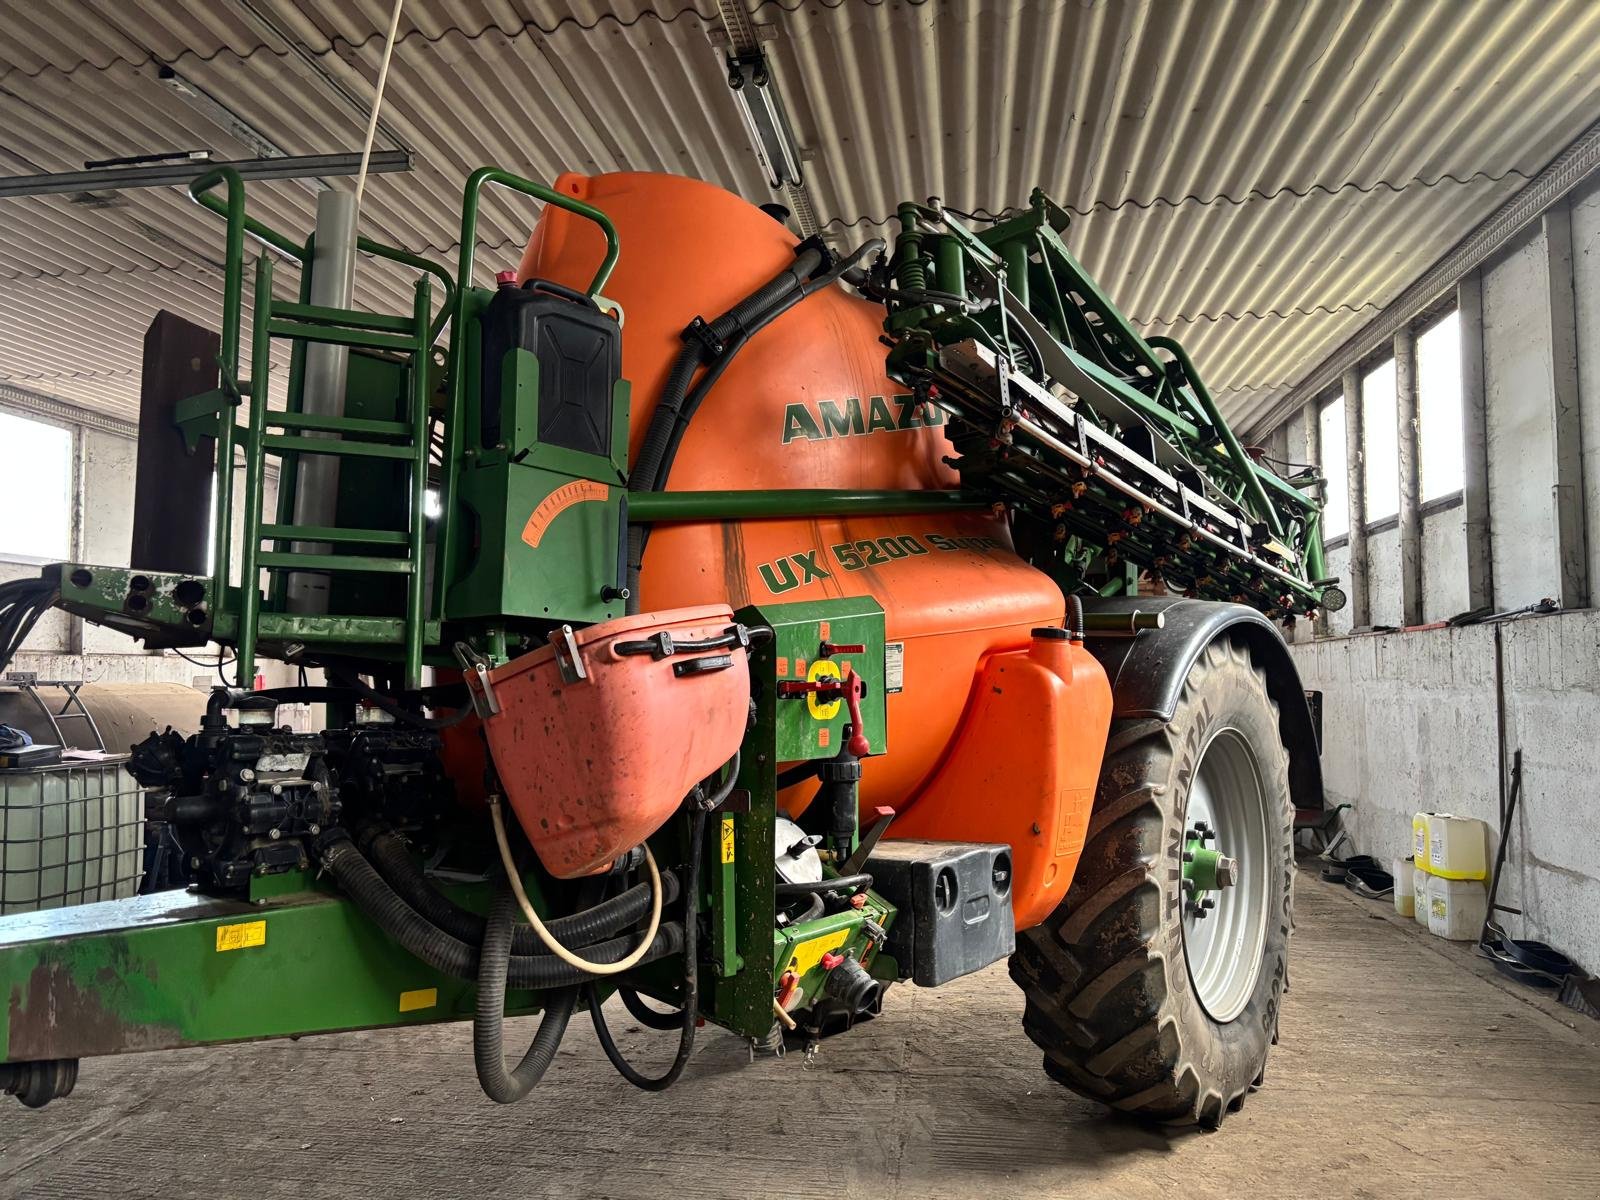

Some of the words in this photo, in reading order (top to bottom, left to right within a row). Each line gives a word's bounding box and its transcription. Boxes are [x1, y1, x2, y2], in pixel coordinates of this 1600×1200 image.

[782, 394, 950, 445] AMAZO
[758, 551, 830, 594] UX
[831, 534, 929, 571] 5200
[1165, 697, 1215, 1025] CONTINENTAL
